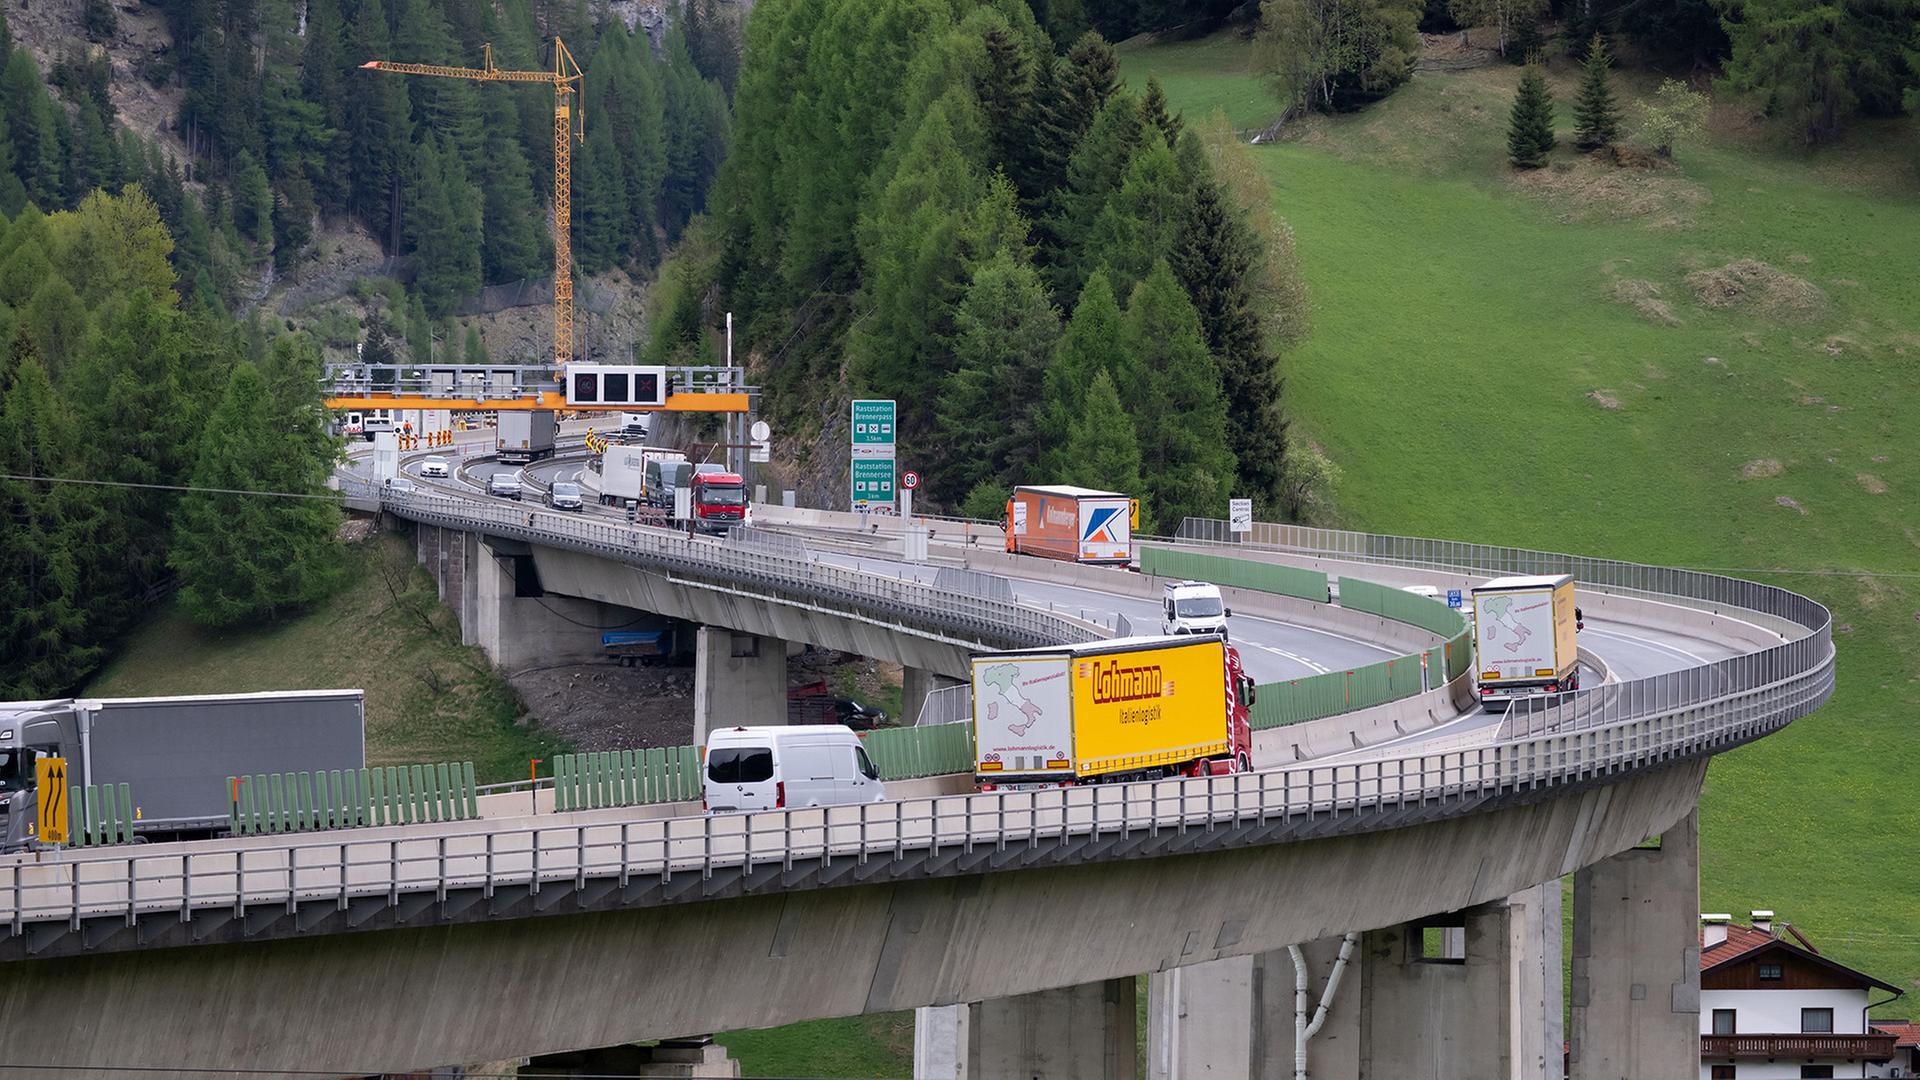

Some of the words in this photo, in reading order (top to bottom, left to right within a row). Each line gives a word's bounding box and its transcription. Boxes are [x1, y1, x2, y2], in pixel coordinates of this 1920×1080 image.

[855, 404, 893, 412] Raststation
[855, 412, 893, 422] Brennerpass
[855, 462, 892, 470] Raststation
[855, 470, 892, 479] Brennersee
[906, 475, 915, 485] 60
[1092, 660, 1161, 704] Lohmann
[1120, 703, 1161, 726] Italienlogistik
